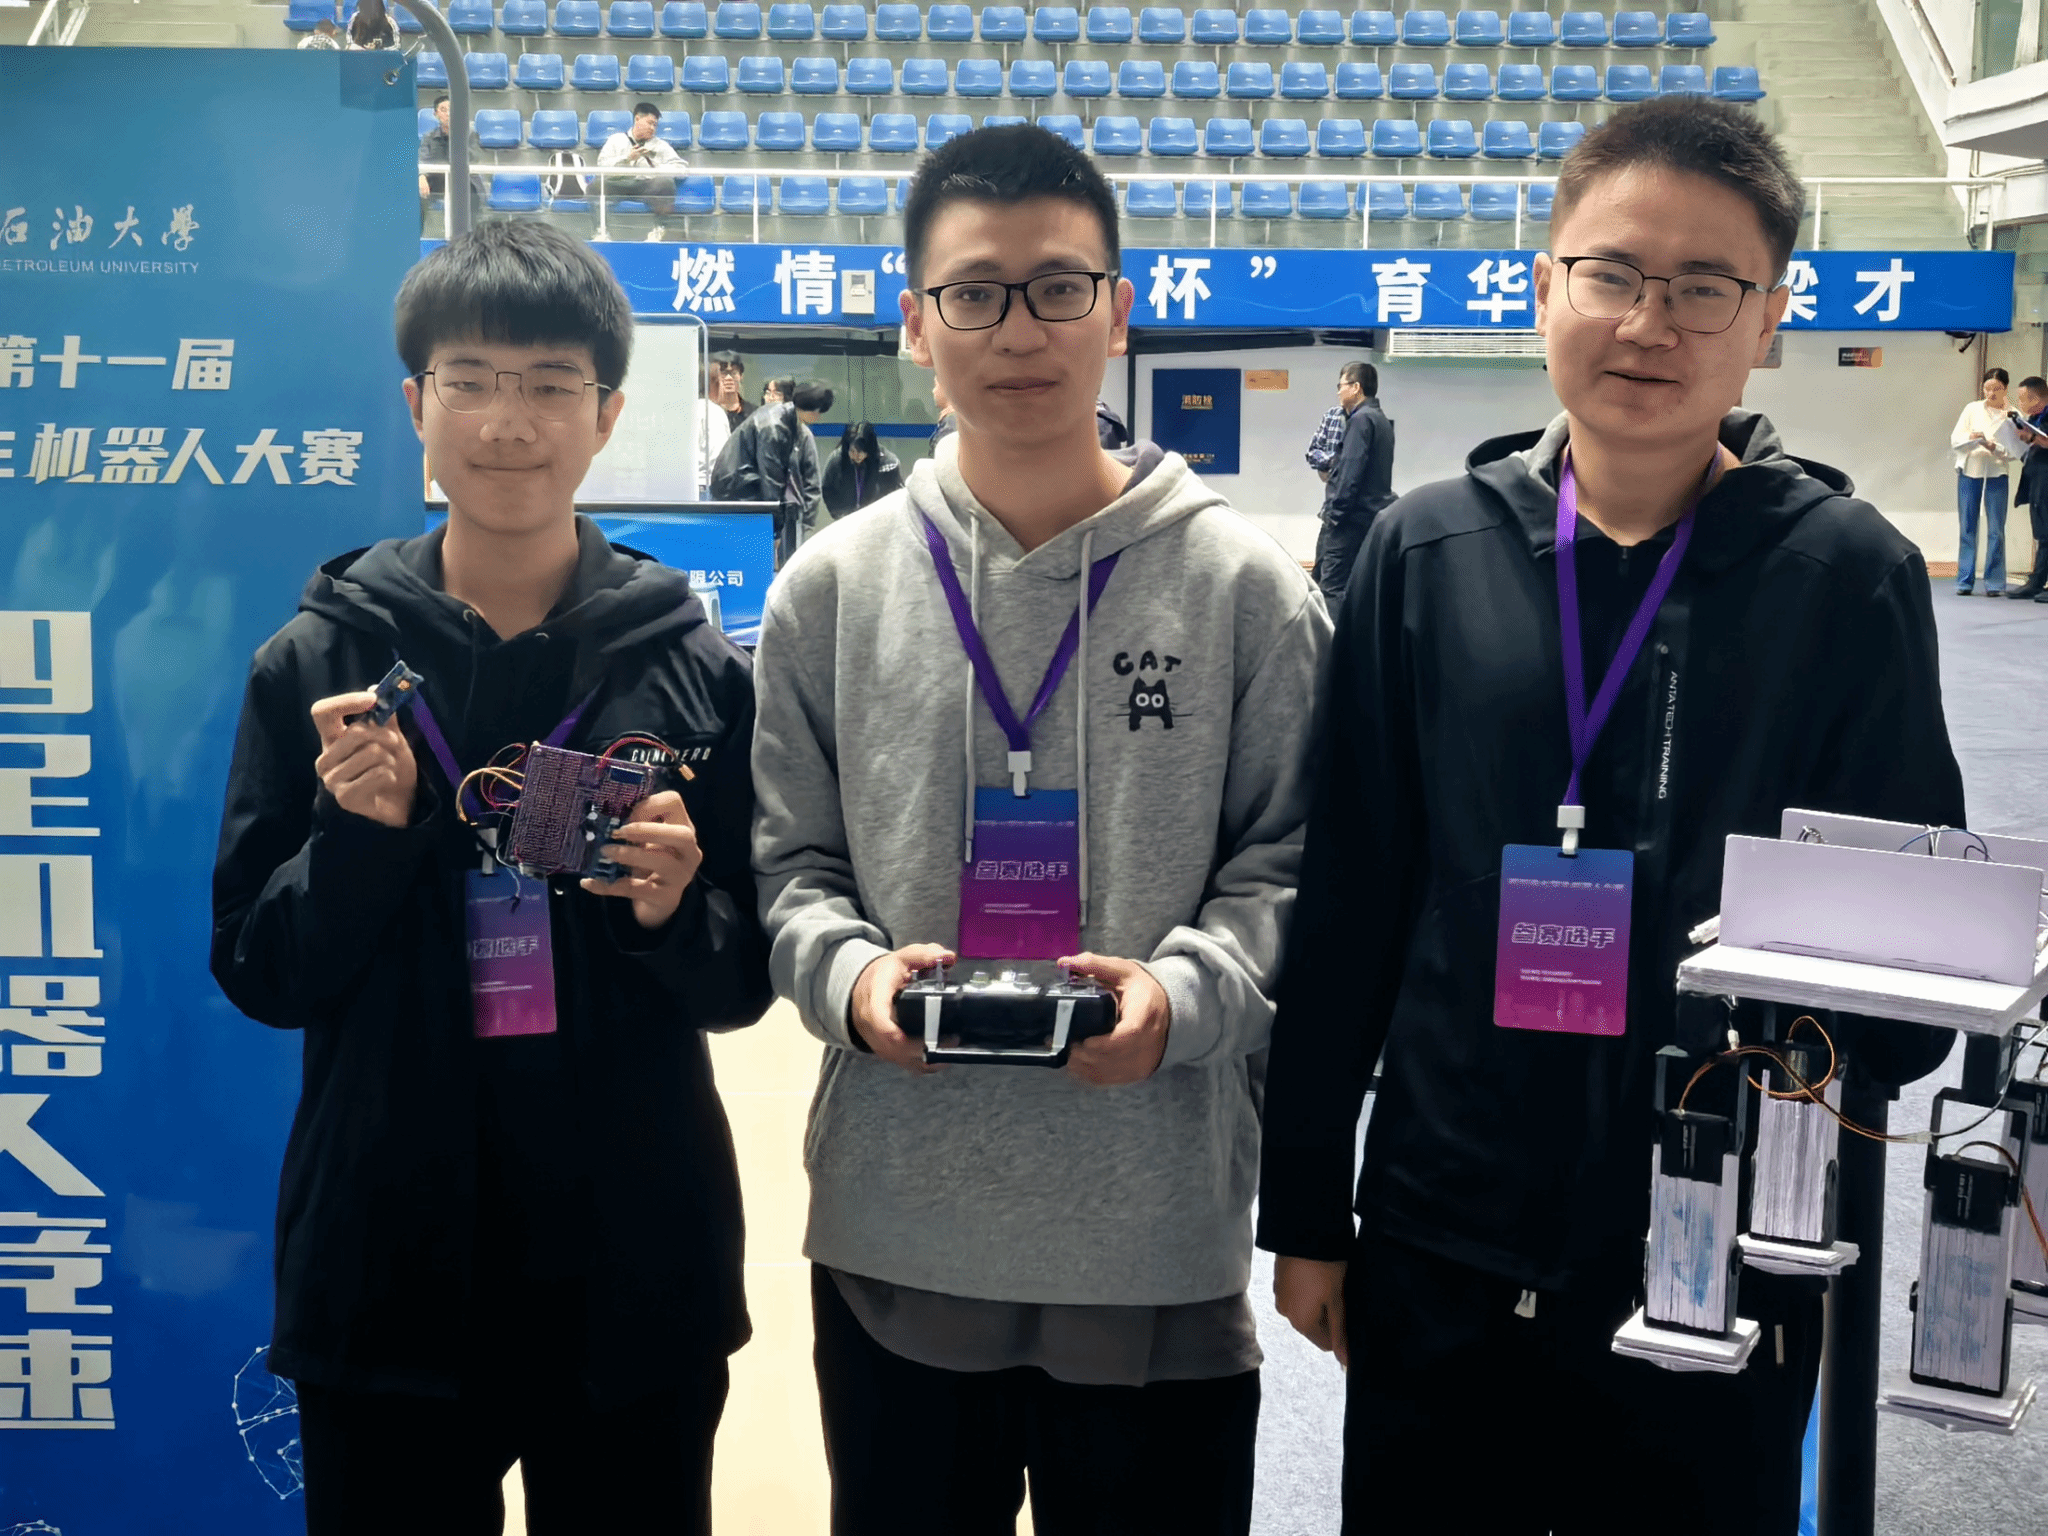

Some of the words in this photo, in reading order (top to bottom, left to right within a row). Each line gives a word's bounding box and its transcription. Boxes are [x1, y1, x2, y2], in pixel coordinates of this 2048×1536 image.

[0, 259, 94, 273] ETROLEUM
[100, 260, 200, 274] UNIVERSITY
[0, 334, 235, 390] 第十一届
[1112, 650, 1182, 676] CAT
[1667, 670, 1679, 704] ANTA
[1658, 738, 1672, 800] TRAINING
[1511, 922, 1616, 949] 参赛选手
